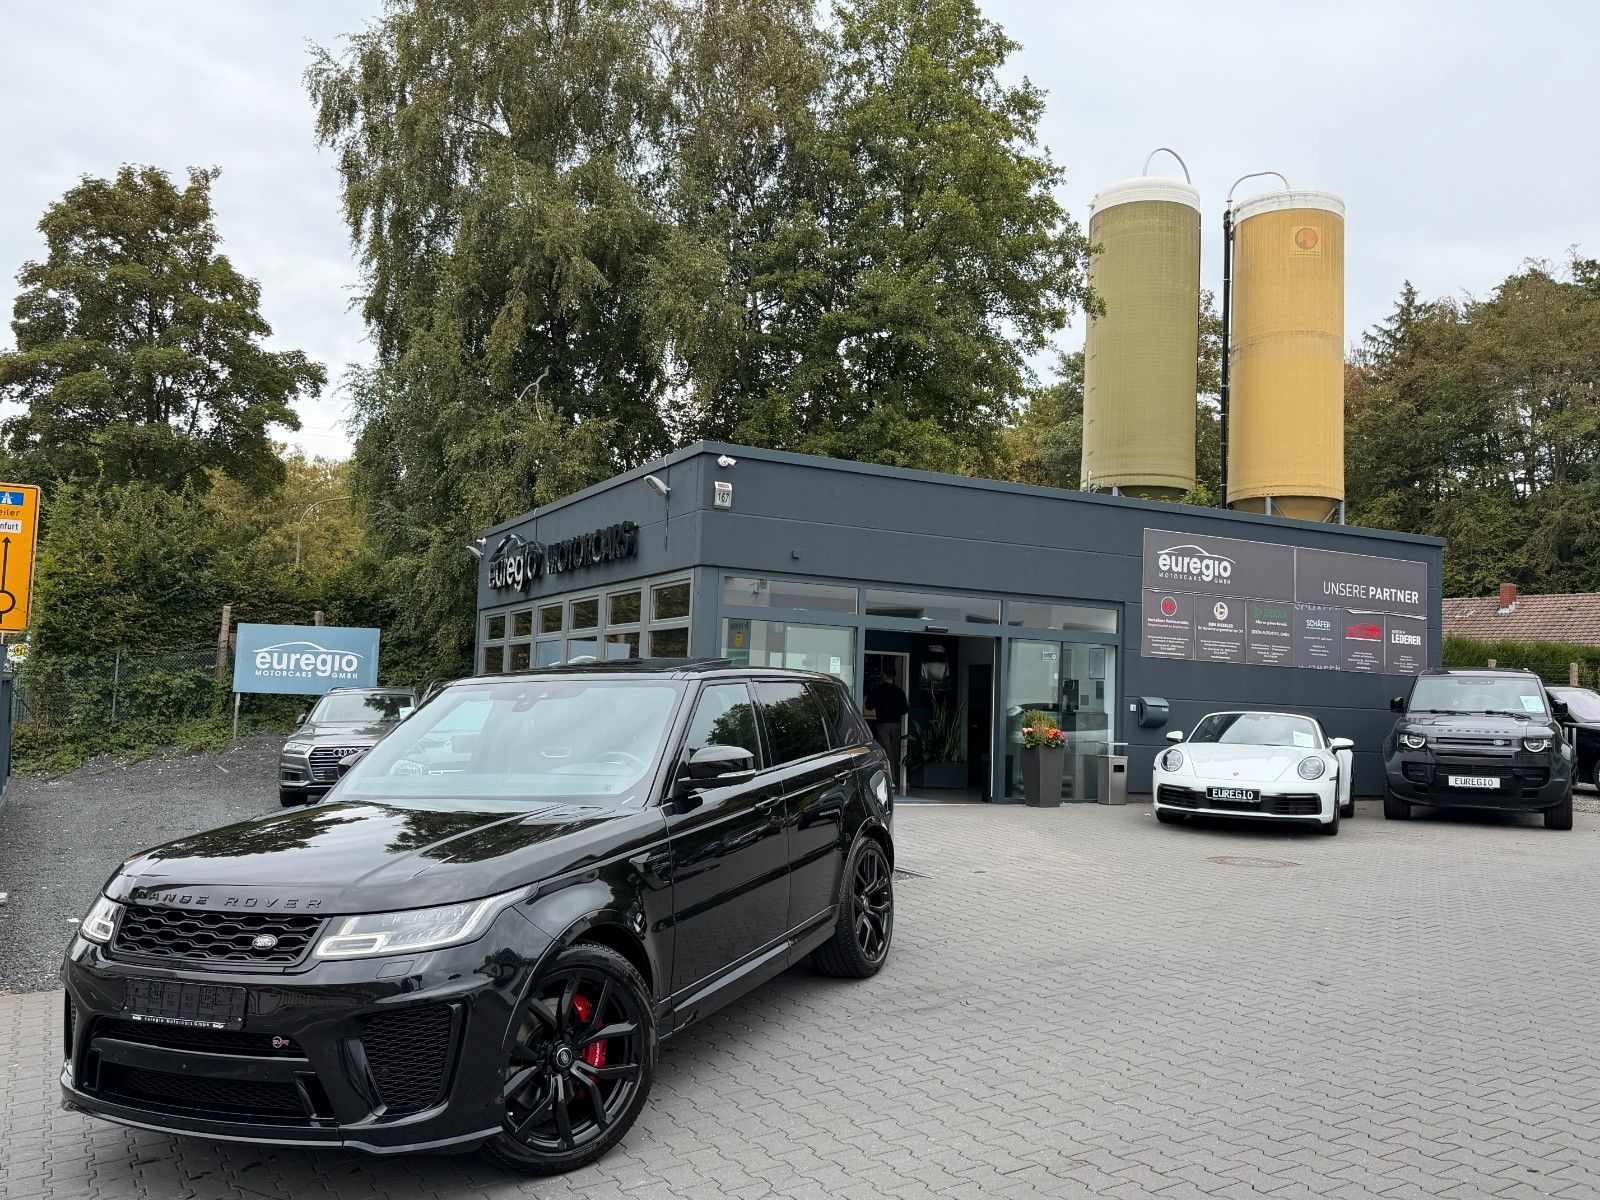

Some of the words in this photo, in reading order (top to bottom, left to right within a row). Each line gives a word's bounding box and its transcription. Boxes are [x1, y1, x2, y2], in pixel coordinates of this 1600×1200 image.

[1158, 554, 1232, 582] euregio
[1158, 572, 1202, 582] MOTORCARS
[1323, 581, 1366, 598] UNSERE
[1369, 586, 1419, 604] PARTNER
[1306, 619, 1331, 628] SCHÄFER
[1391, 633, 1421, 646] LEDERER
[255, 652, 358, 677] euregio
[255, 669, 312, 678] MOTORCARS
[1454, 777, 1493, 787] EUREGIO
[1212, 788, 1254, 800] EUREGIO
[135, 889, 210, 905] RANGE
[224, 896, 322, 909] ROVER
